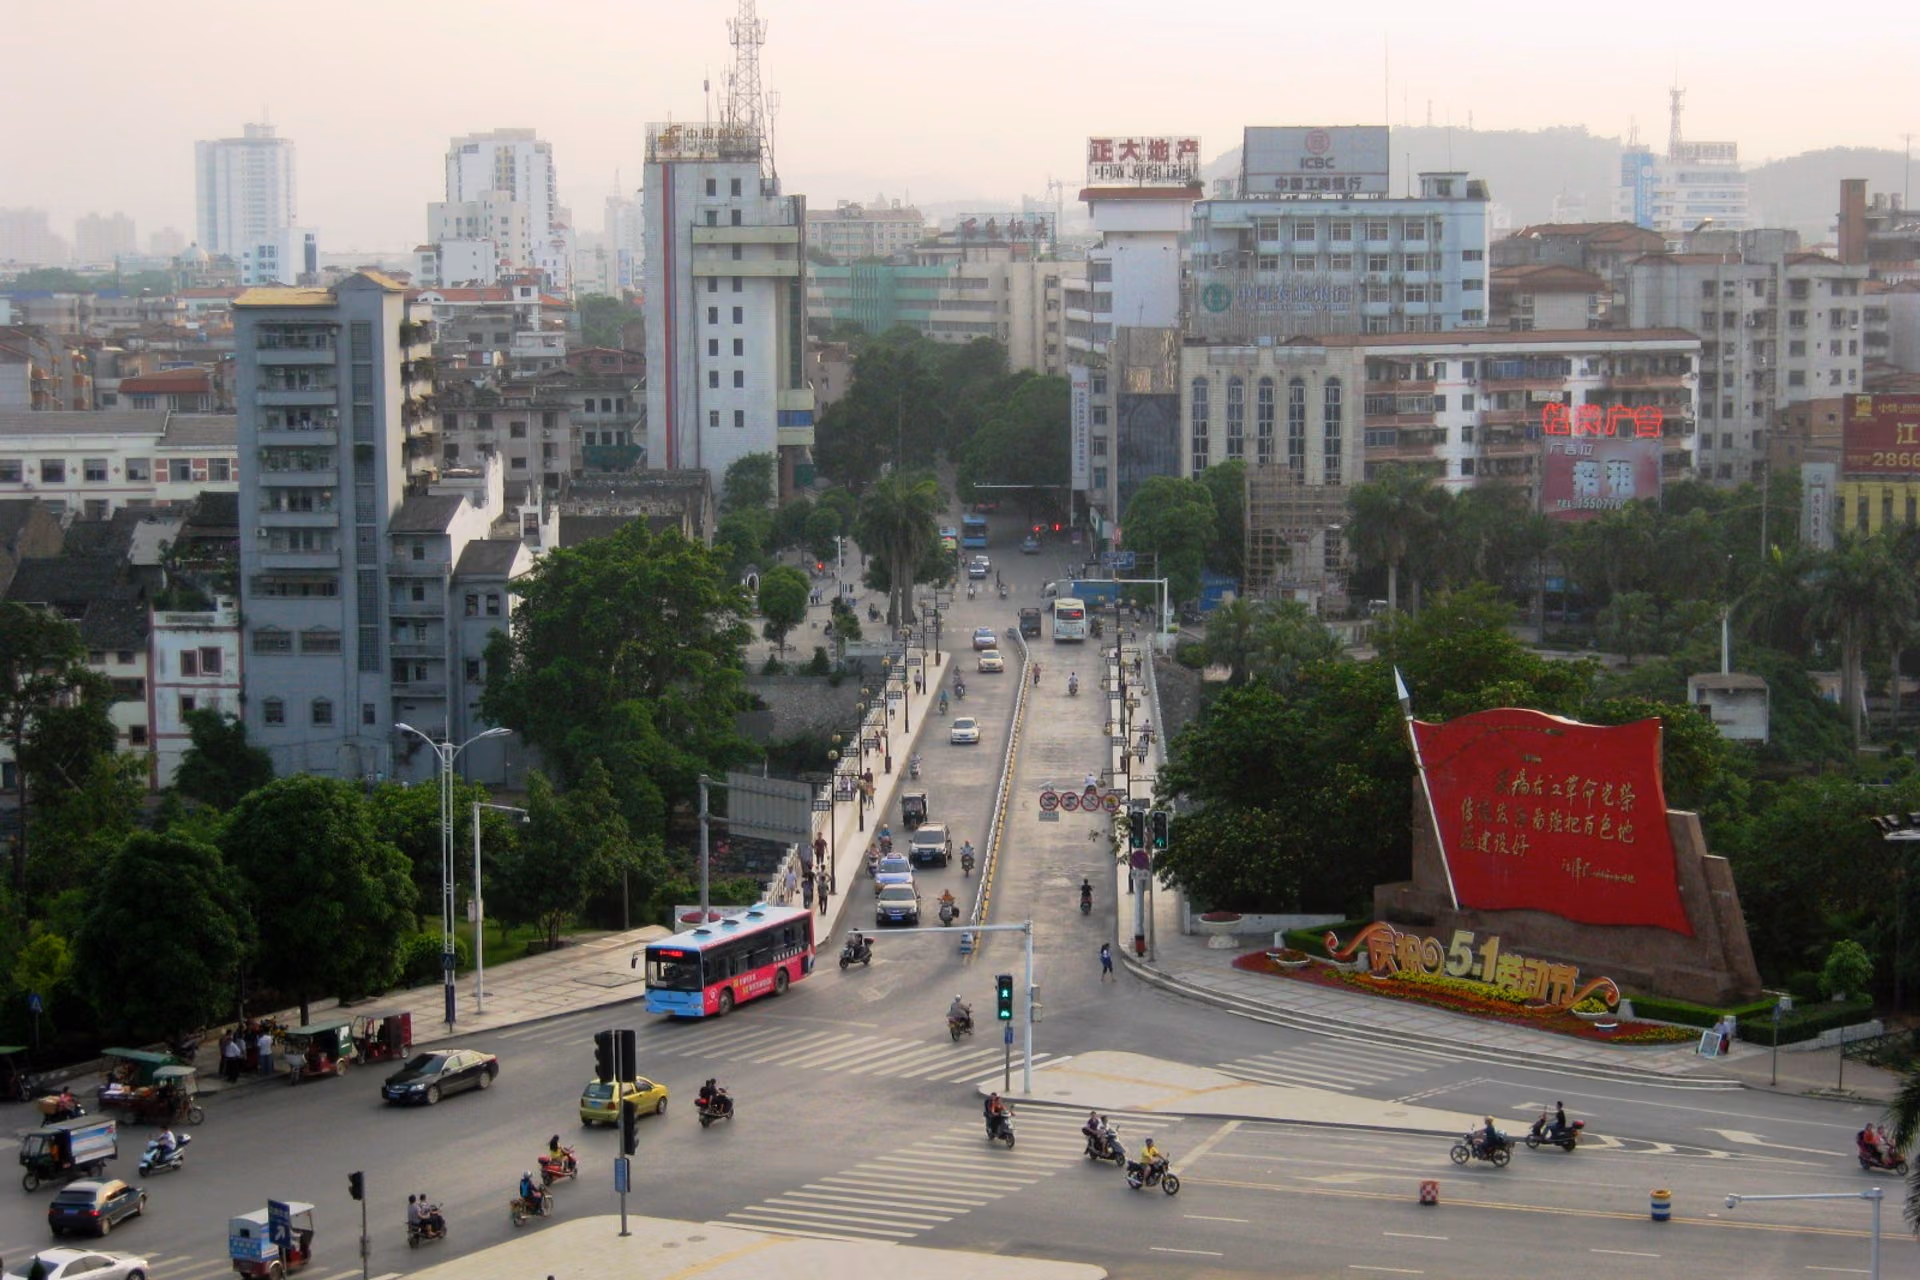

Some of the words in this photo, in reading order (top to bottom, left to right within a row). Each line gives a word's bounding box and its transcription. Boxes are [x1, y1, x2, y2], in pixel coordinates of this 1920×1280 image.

[1089, 138, 1199, 163] 正大地产
[1299, 156, 1336, 169] ICBC
[1275, 176, 1362, 191] 中国工商银行
